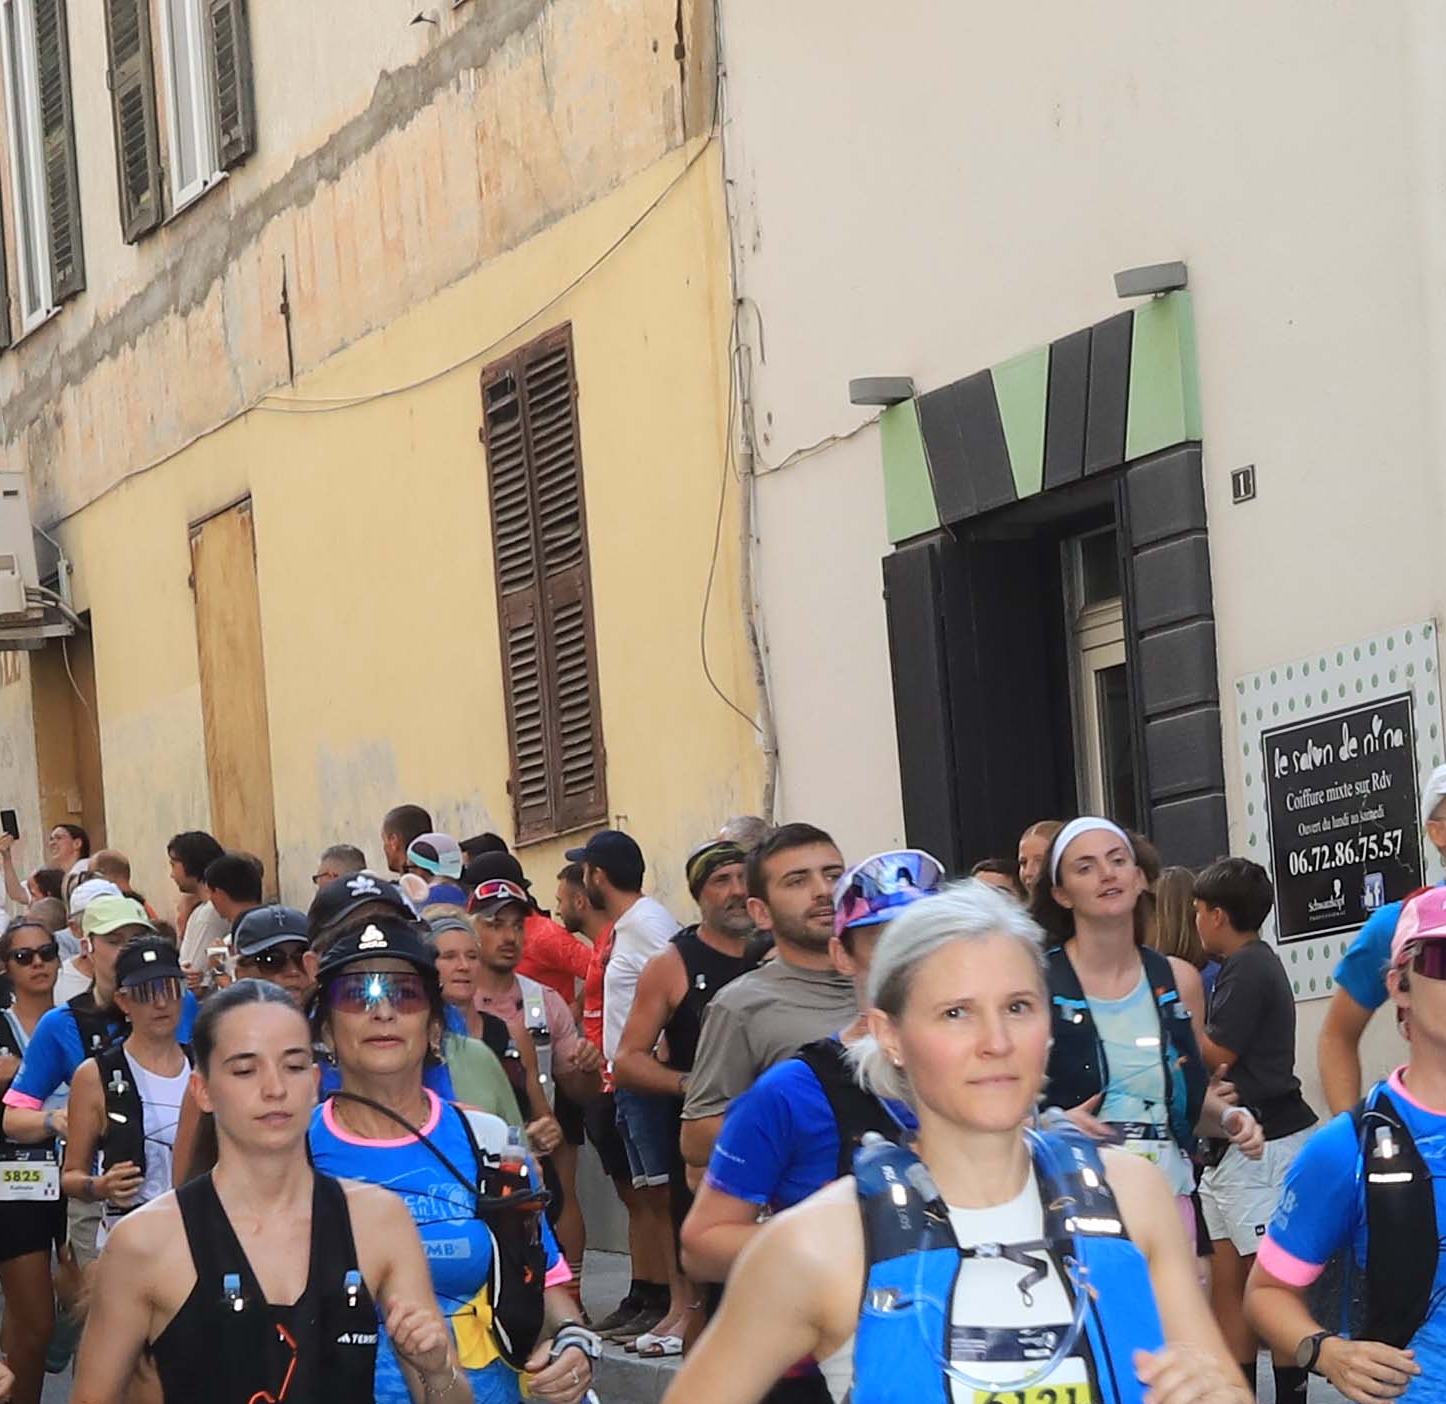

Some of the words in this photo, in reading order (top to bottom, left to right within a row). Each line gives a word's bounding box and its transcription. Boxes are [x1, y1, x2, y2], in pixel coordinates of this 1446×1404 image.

[1274, 747, 1288, 779] le
[1339, 722, 1358, 760] de
[1286, 786, 1325, 812] Coiffure
[1326, 781, 1354, 802] mixte
[1355, 778, 1371, 796] sur
[1372, 770, 1393, 793] Rdv
[1298, 817, 1321, 838] Ouvert
[1332, 811, 1350, 830] lundi
[1289, 829, 1403, 876] 06.72.86.75.57
[4, 1170, 40, 1182] 5825
